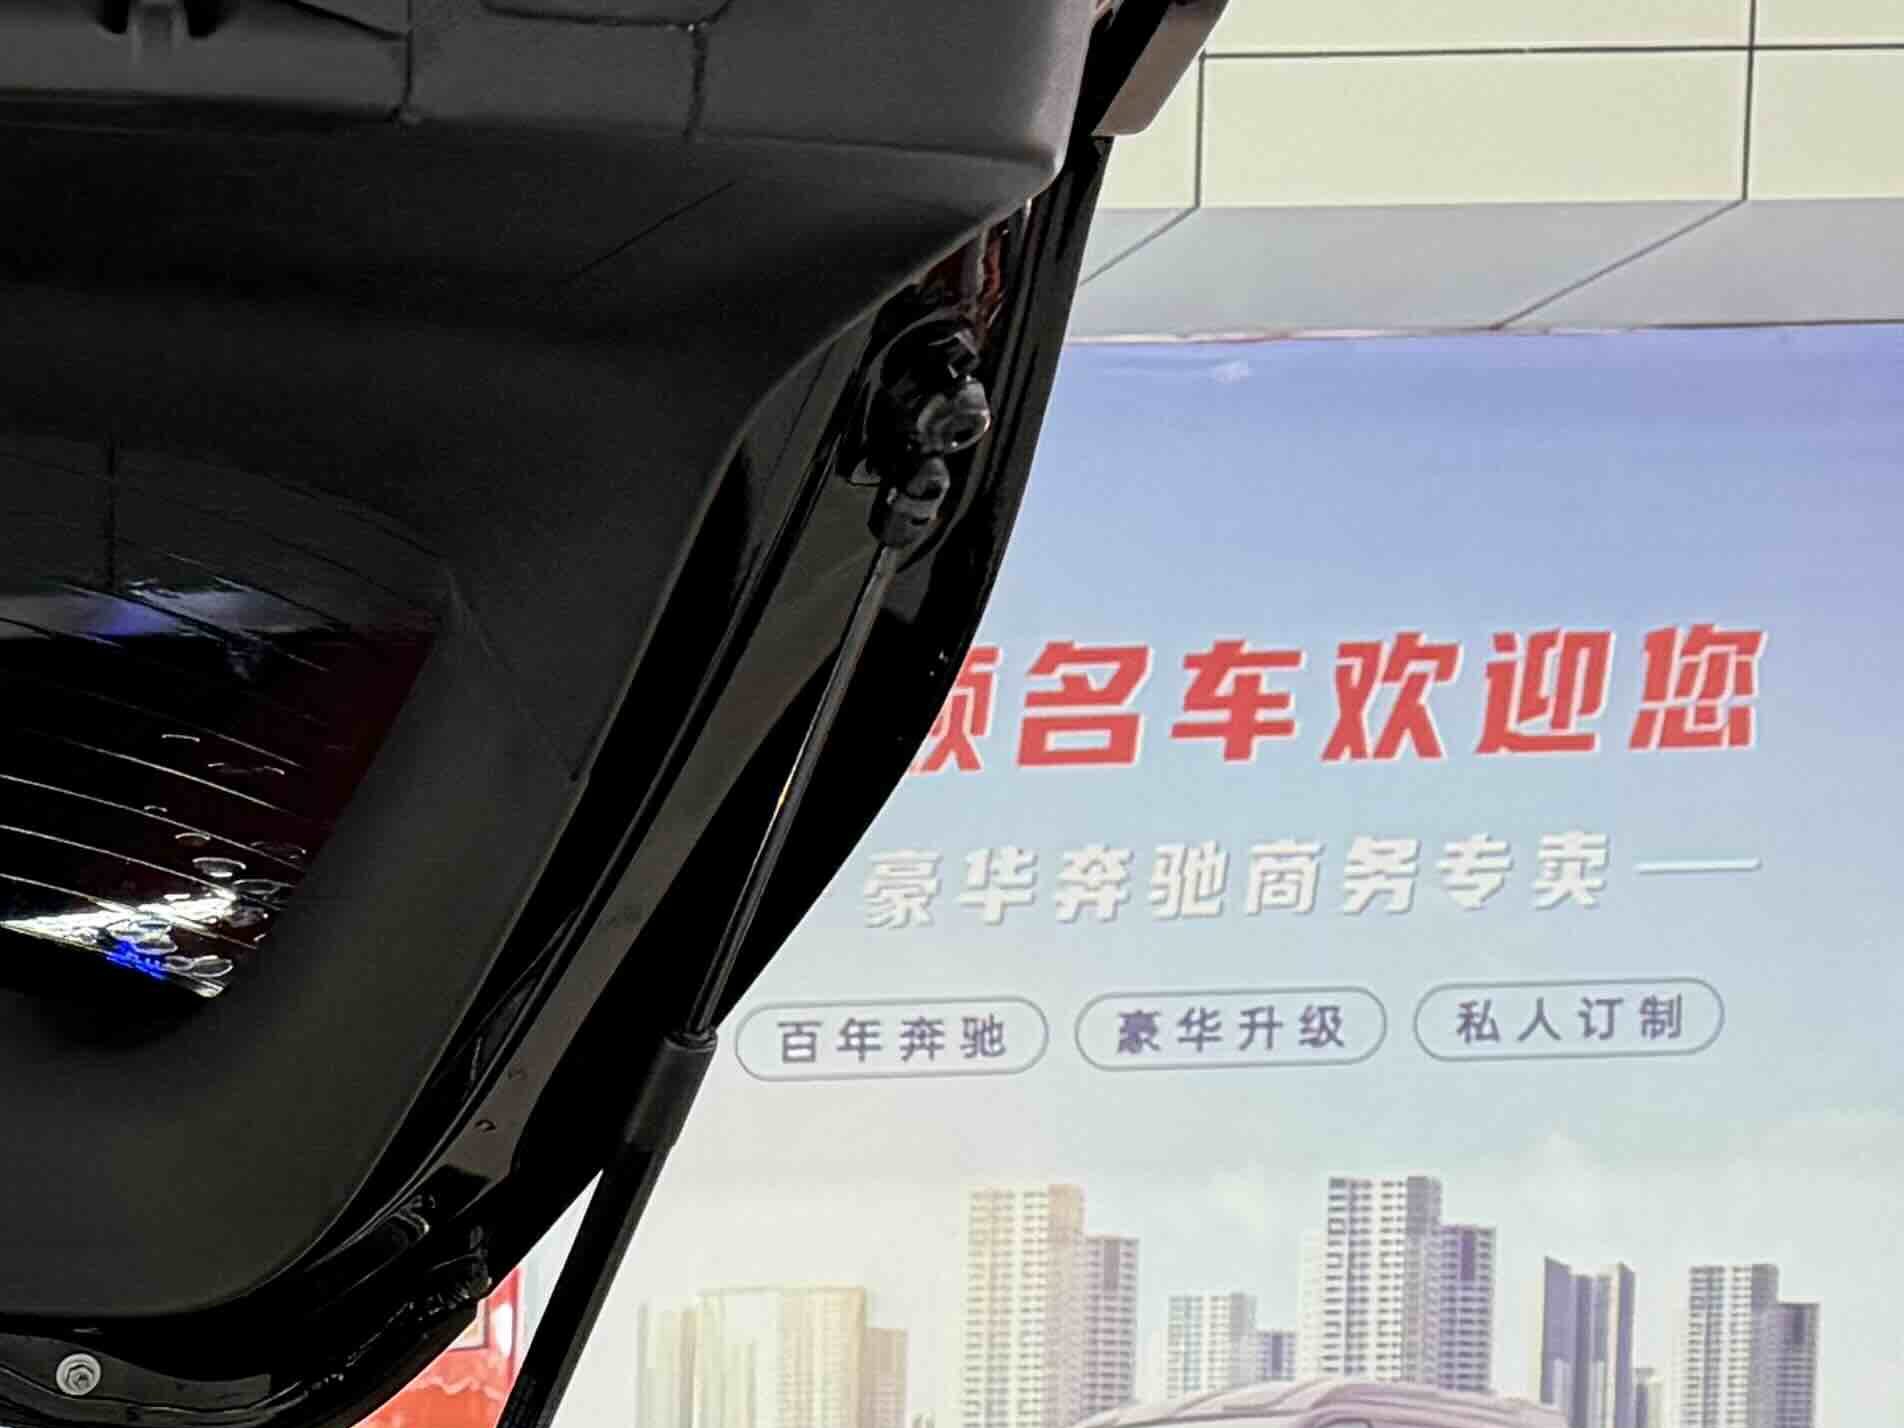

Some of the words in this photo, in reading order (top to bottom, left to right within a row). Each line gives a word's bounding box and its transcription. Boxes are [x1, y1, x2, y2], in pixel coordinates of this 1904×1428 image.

[860, 830, 1612, 930] 豪华奔驰商务专卖
[777, 1014, 1007, 1064] 百年奔驰
[1115, 1004, 1347, 1056] 豪华升级
[1454, 990, 1685, 1046] 私人订制
